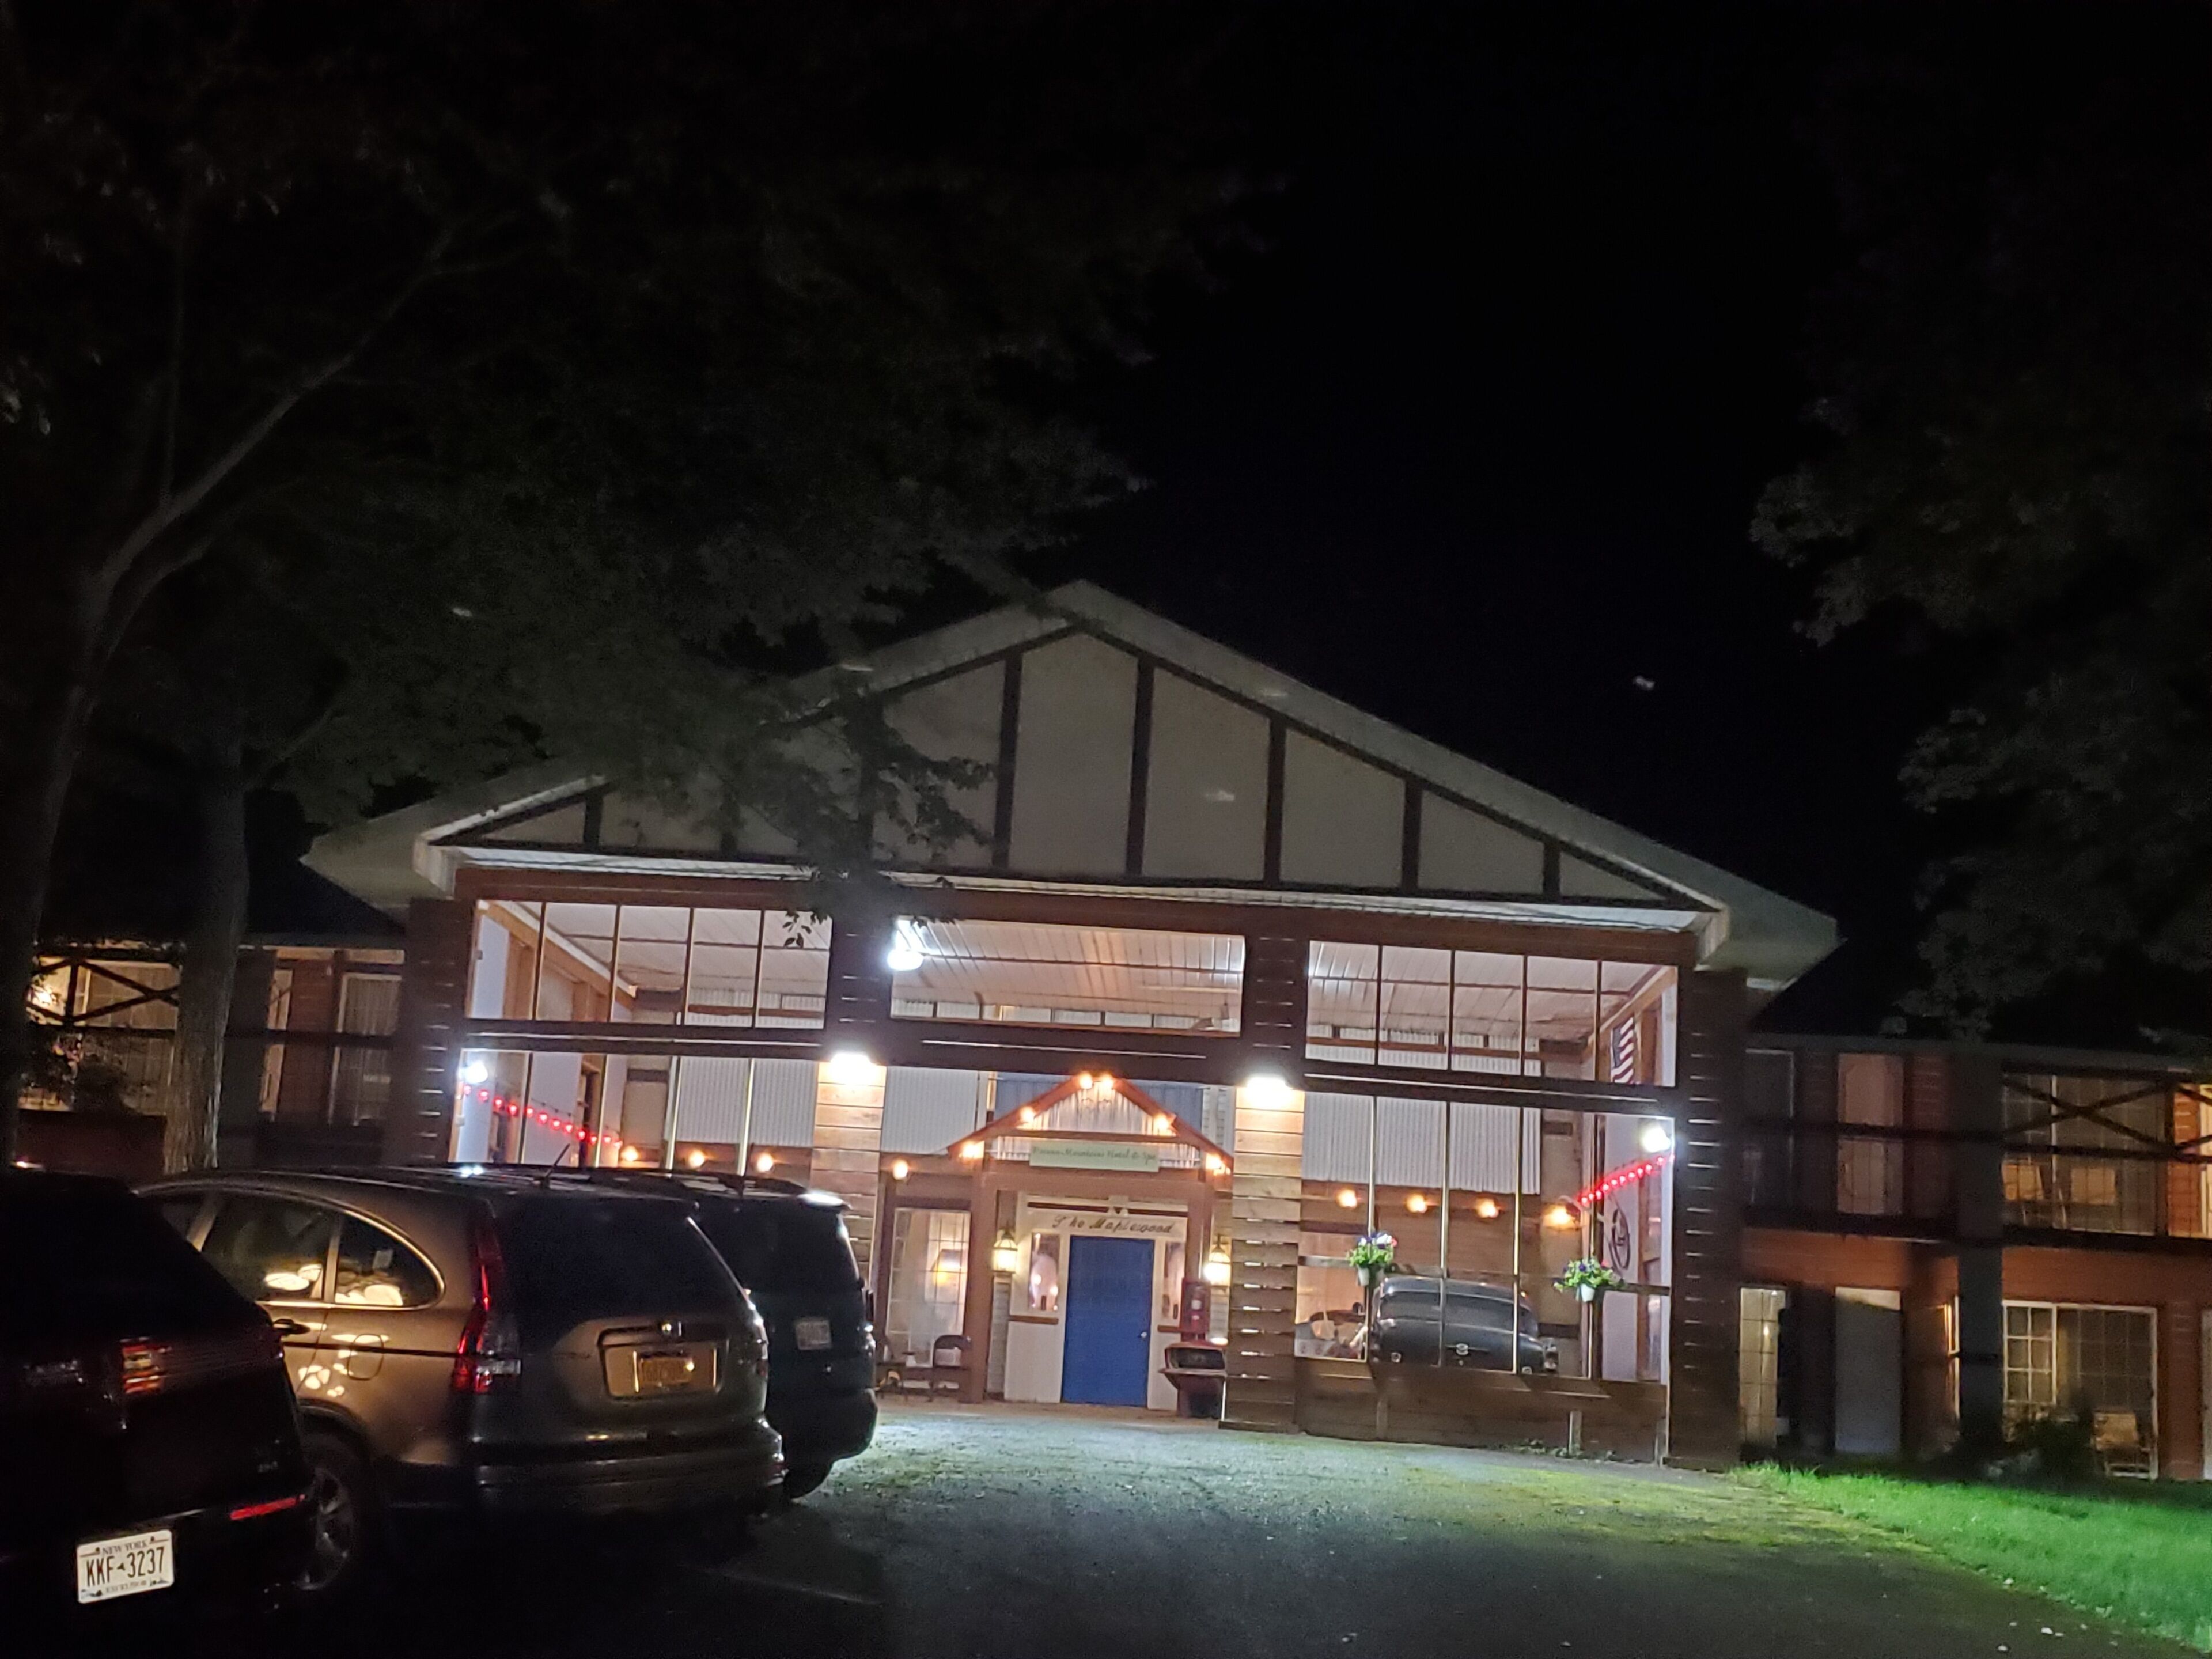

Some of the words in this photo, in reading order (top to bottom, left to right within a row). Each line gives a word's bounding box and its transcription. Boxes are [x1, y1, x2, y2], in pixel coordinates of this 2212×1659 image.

[1142, 1151, 1156, 1166] Spa
[1052, 1215, 1085, 1228] The
[1089, 1217, 1175, 1233] Maplewood
[102, 1545, 122, 1555] NEW
[124, 1540, 148, 1551] YORK
[86, 1556, 115, 1588] KKF
[126, 1547, 165, 1578] 3237
